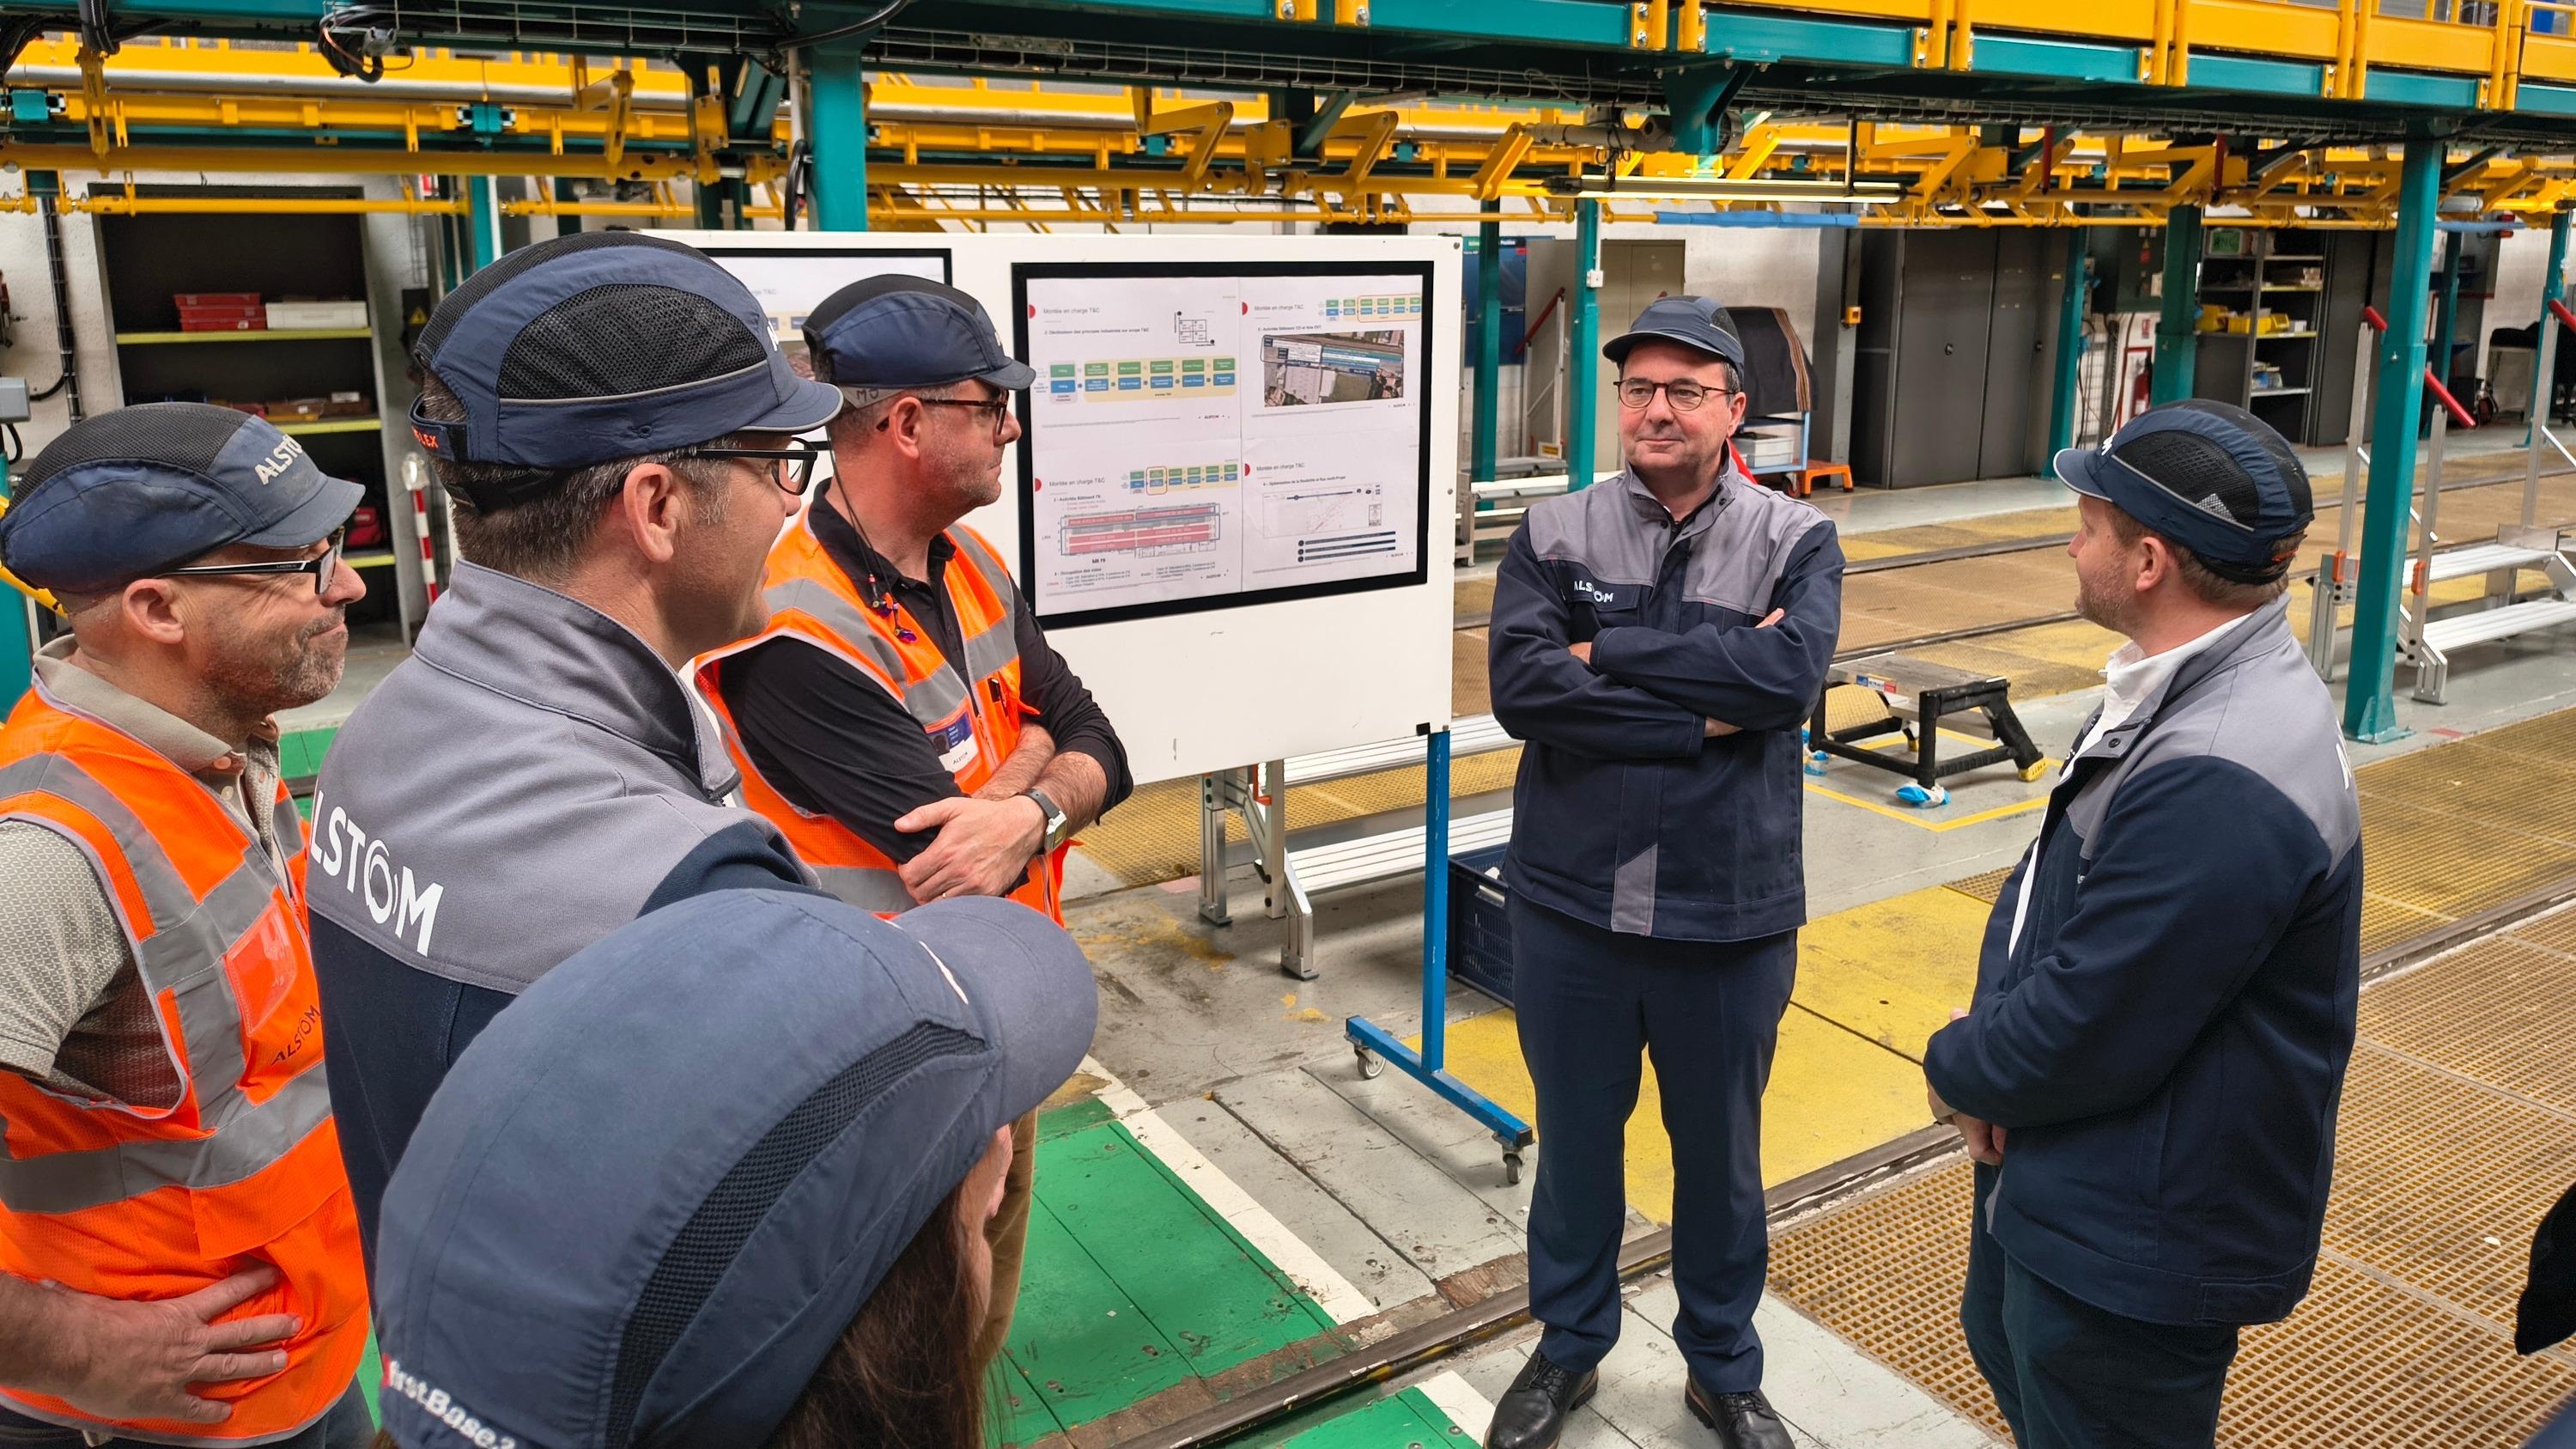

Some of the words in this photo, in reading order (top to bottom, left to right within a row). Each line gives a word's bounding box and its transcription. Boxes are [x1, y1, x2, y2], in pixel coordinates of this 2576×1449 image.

[255, 434, 303, 485] ALSTO
[1573, 580, 1614, 603] ALSOM
[309, 789, 444, 958] LSTOM
[270, 1004, 323, 1066] ALSTOM
